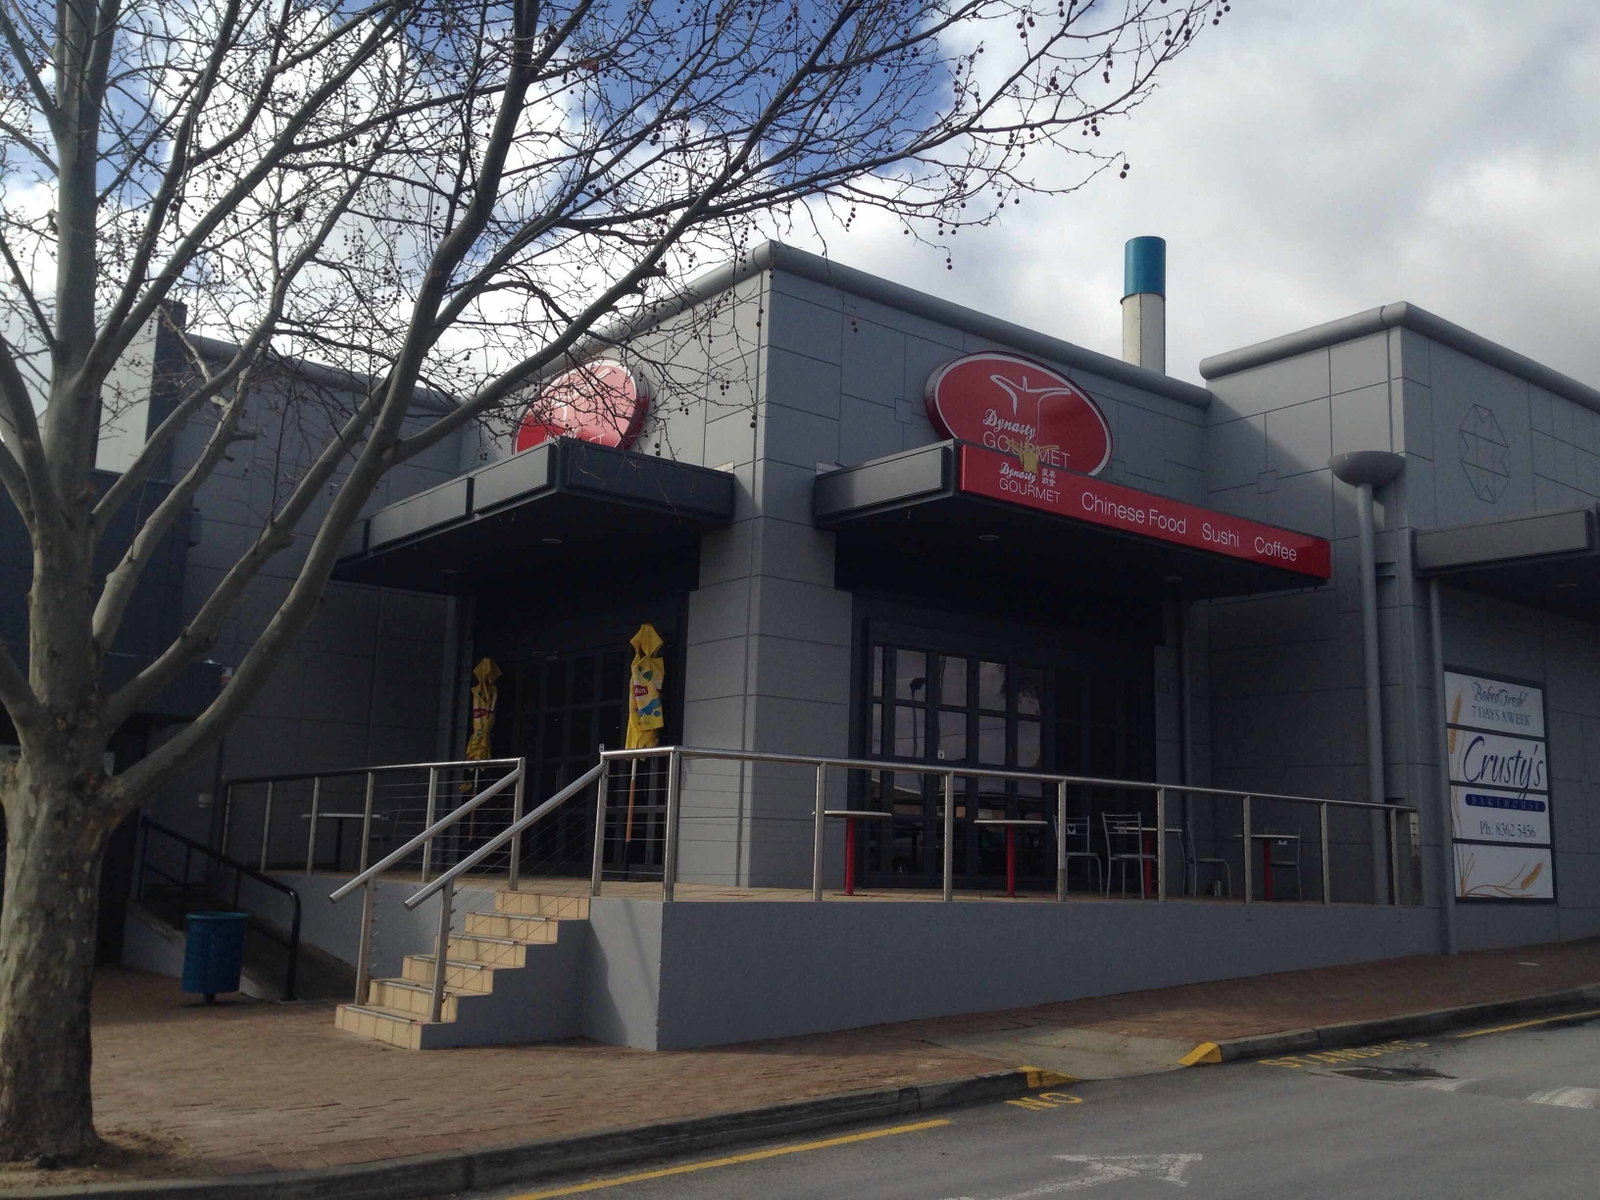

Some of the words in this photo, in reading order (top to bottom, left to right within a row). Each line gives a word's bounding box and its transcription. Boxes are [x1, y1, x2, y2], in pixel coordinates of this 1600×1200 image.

[983, 408, 1036, 440] Dynasty
[999, 462, 1036, 484] Dynasty
[999, 478, 1061, 503] GOURMET
[1081, 491, 1145, 524] Chinese
[1149, 508, 1187, 534] Food
[1202, 522, 1240, 548] Sushi
[1254, 536, 1297, 562] Coffee
[1471, 705, 1476, 717] 7
[1478, 706, 1500, 721] DAYS
[1500, 710, 1507, 723] A
[1507, 711, 1531, 727] WEEK
[1463, 735, 1544, 800] Crusty's
[1002, 1091, 1083, 1111] NO
